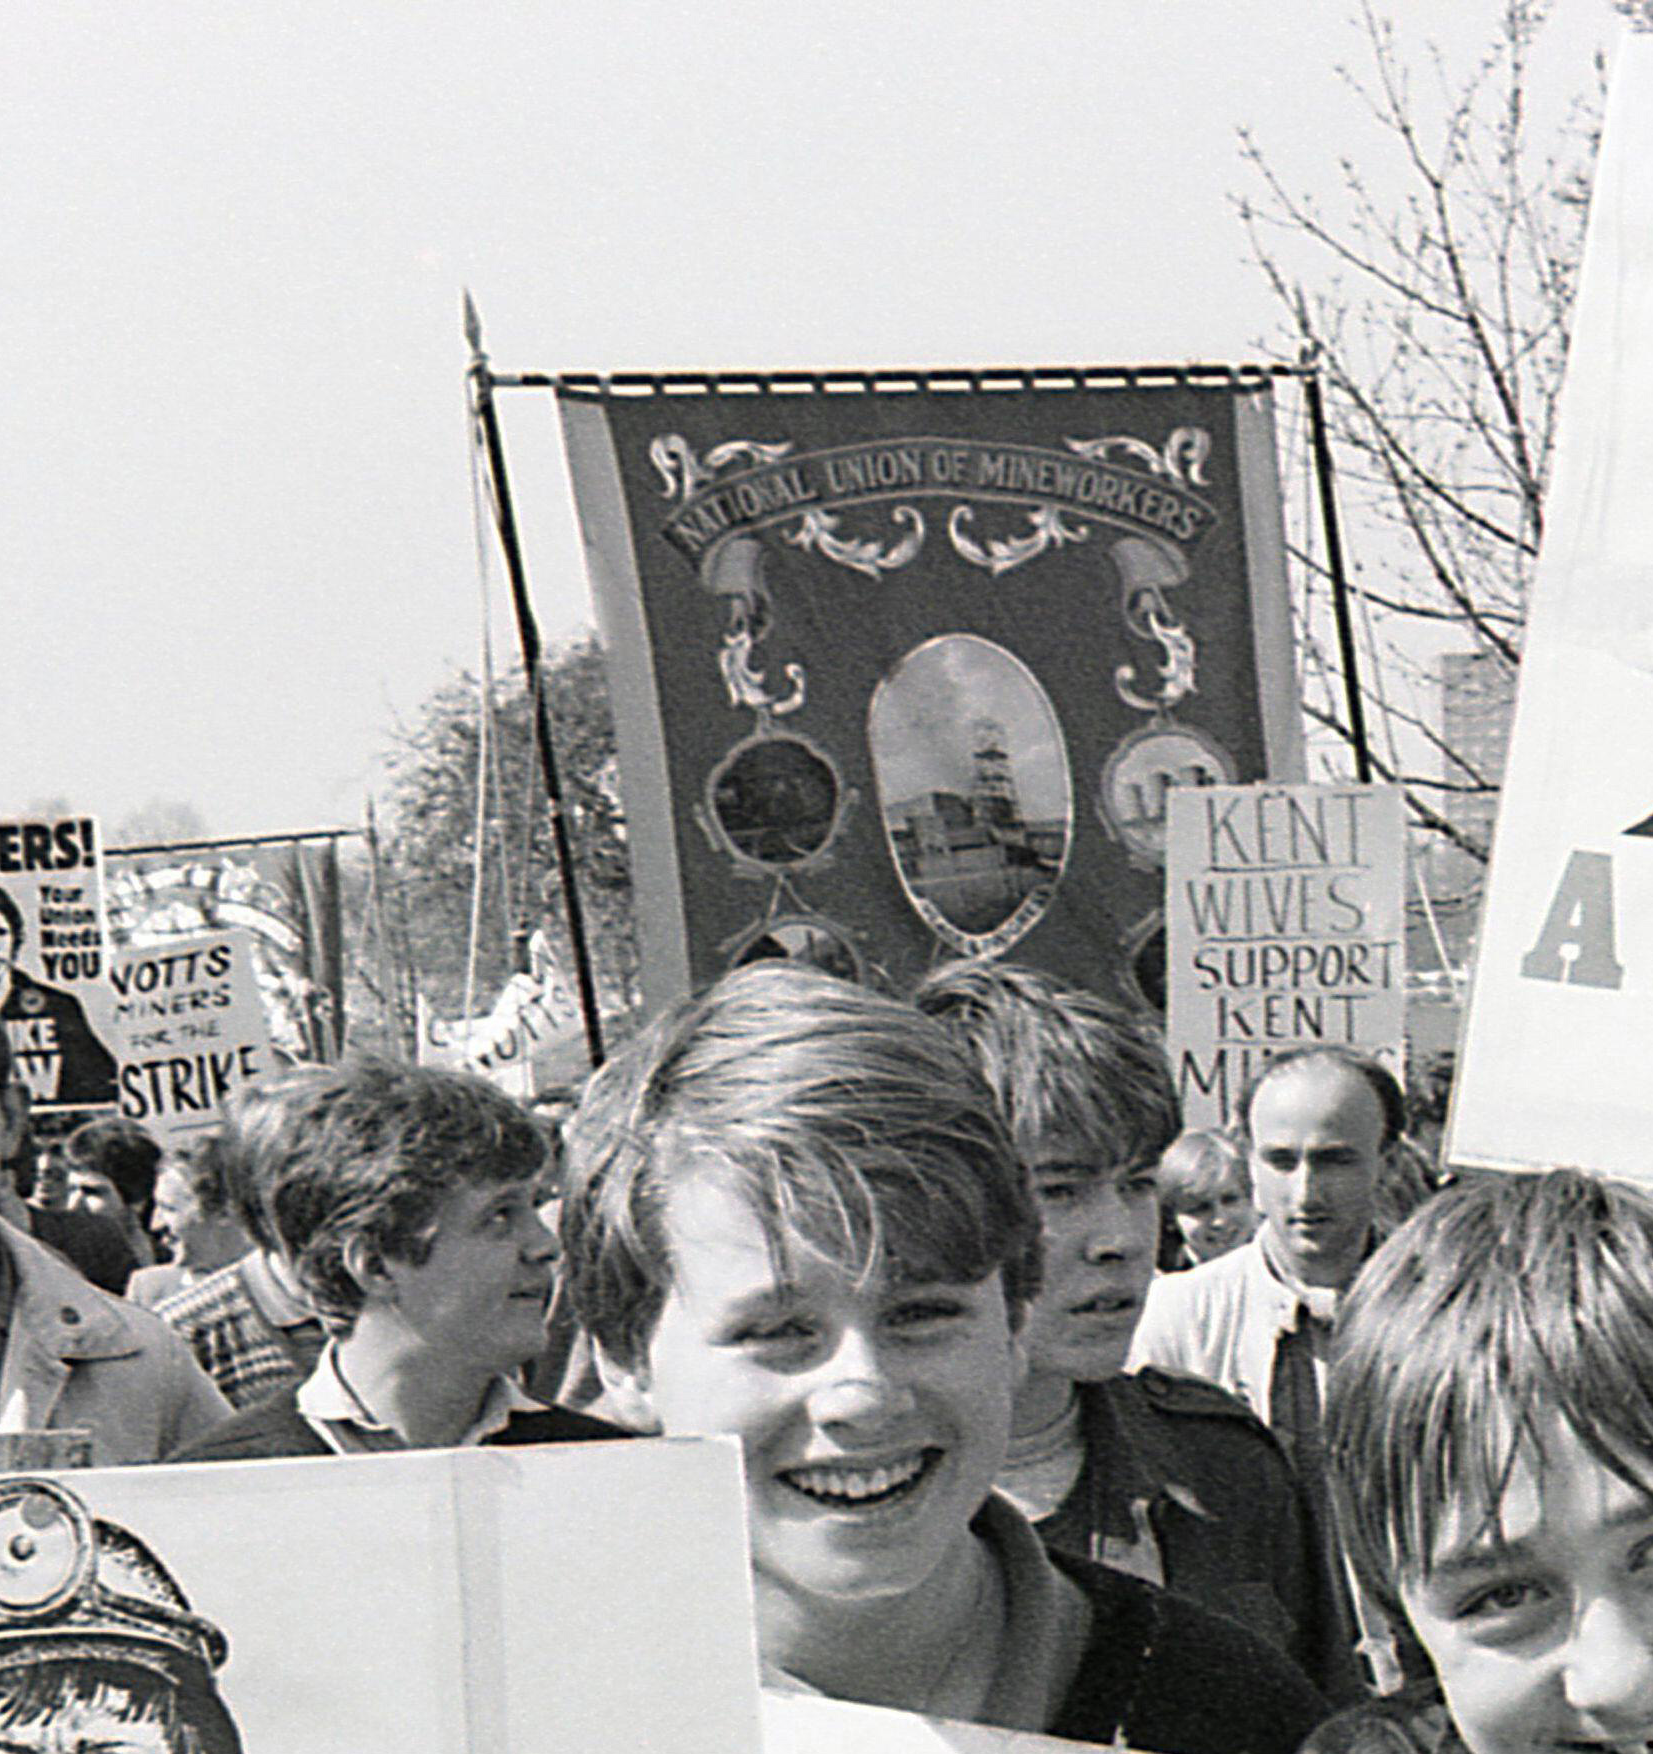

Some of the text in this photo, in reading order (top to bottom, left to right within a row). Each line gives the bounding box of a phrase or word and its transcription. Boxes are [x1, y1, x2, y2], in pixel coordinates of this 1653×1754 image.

[676, 448, 1204, 553] NATIONAL UNION OF MINEWORKERS
[1205, 791, 1375, 867] KENT
[1185, 874, 1366, 935] WIVES
[1520, 850, 1624, 990] A
[42, 951, 101, 981] YOU
[1194, 941, 1399, 991] SUPPORT
[112, 981, 233, 1026] MINERS
[1217, 995, 1369, 1043] KENT
[121, 1044, 263, 1119] STRIKE
